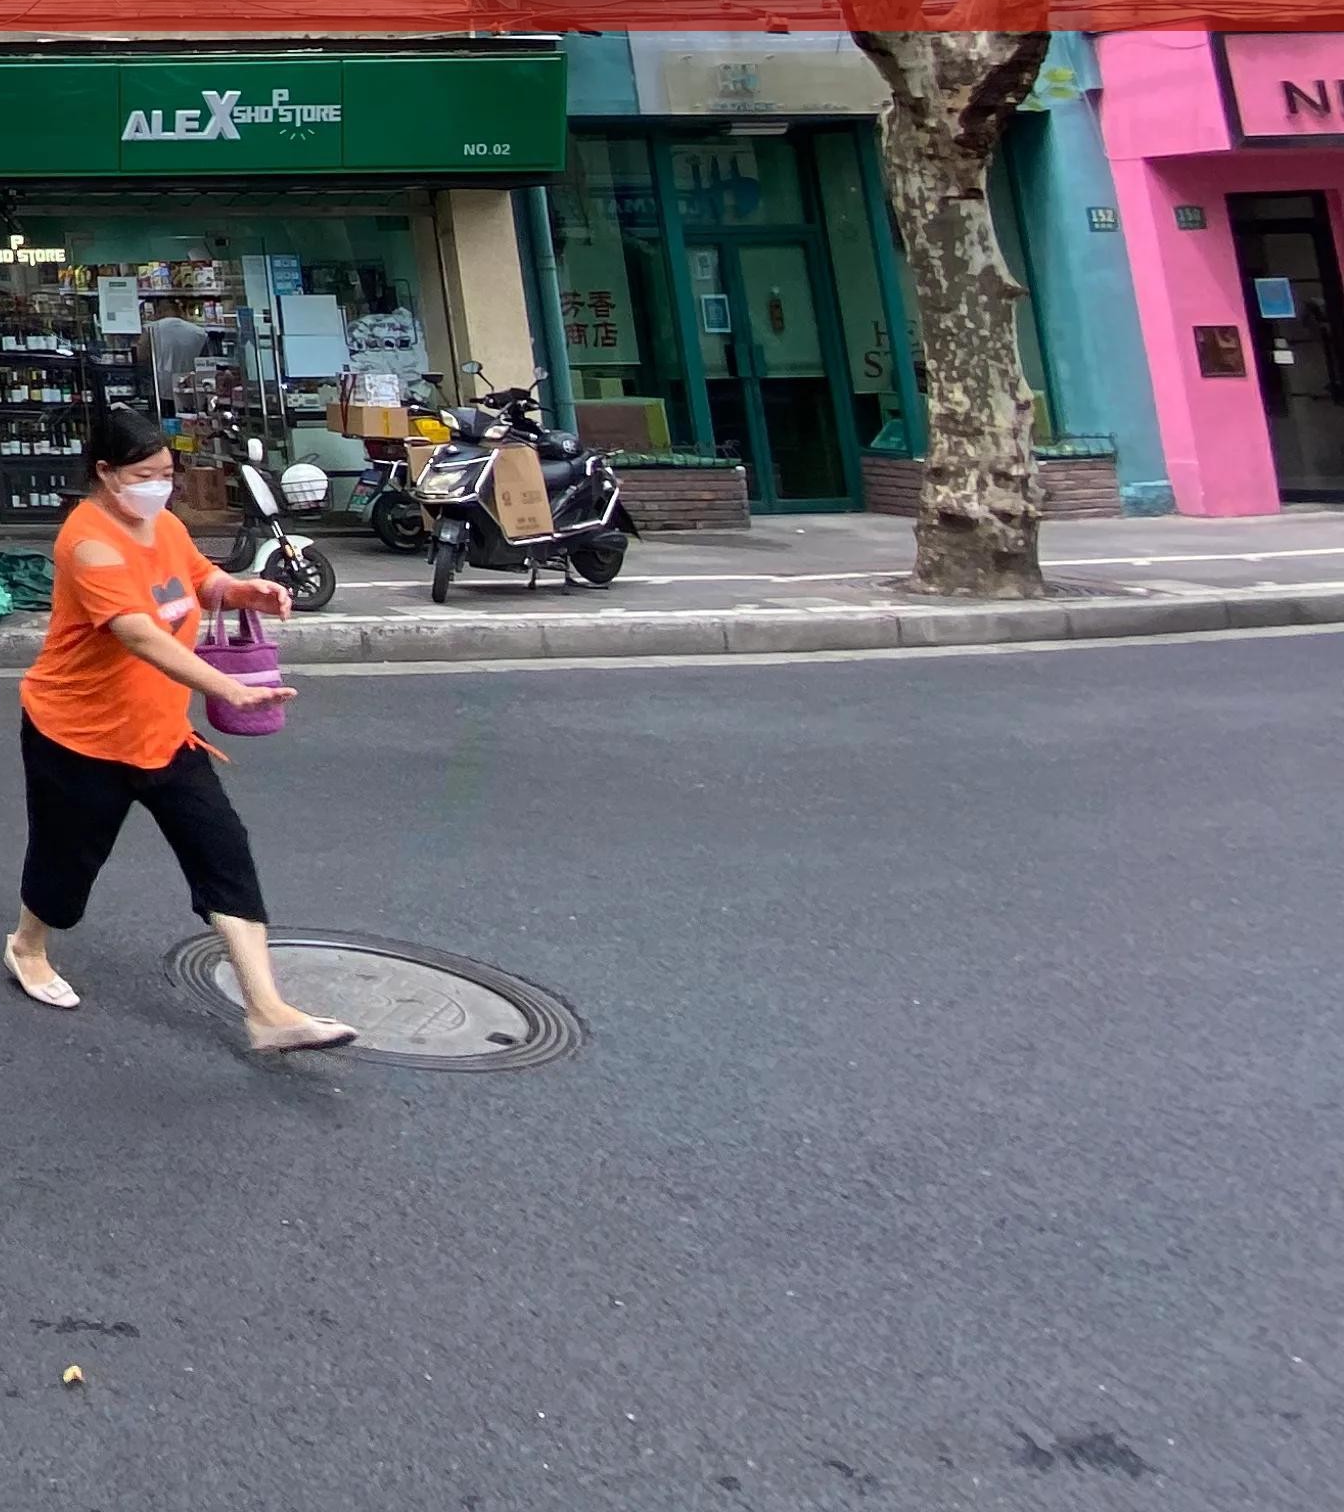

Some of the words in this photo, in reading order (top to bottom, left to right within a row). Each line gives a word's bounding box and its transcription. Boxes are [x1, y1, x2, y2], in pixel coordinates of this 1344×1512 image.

[1280, 79, 1344, 115] N
[121, 90, 241, 141] ALEX
[464, 143, 511, 156] NO.02
